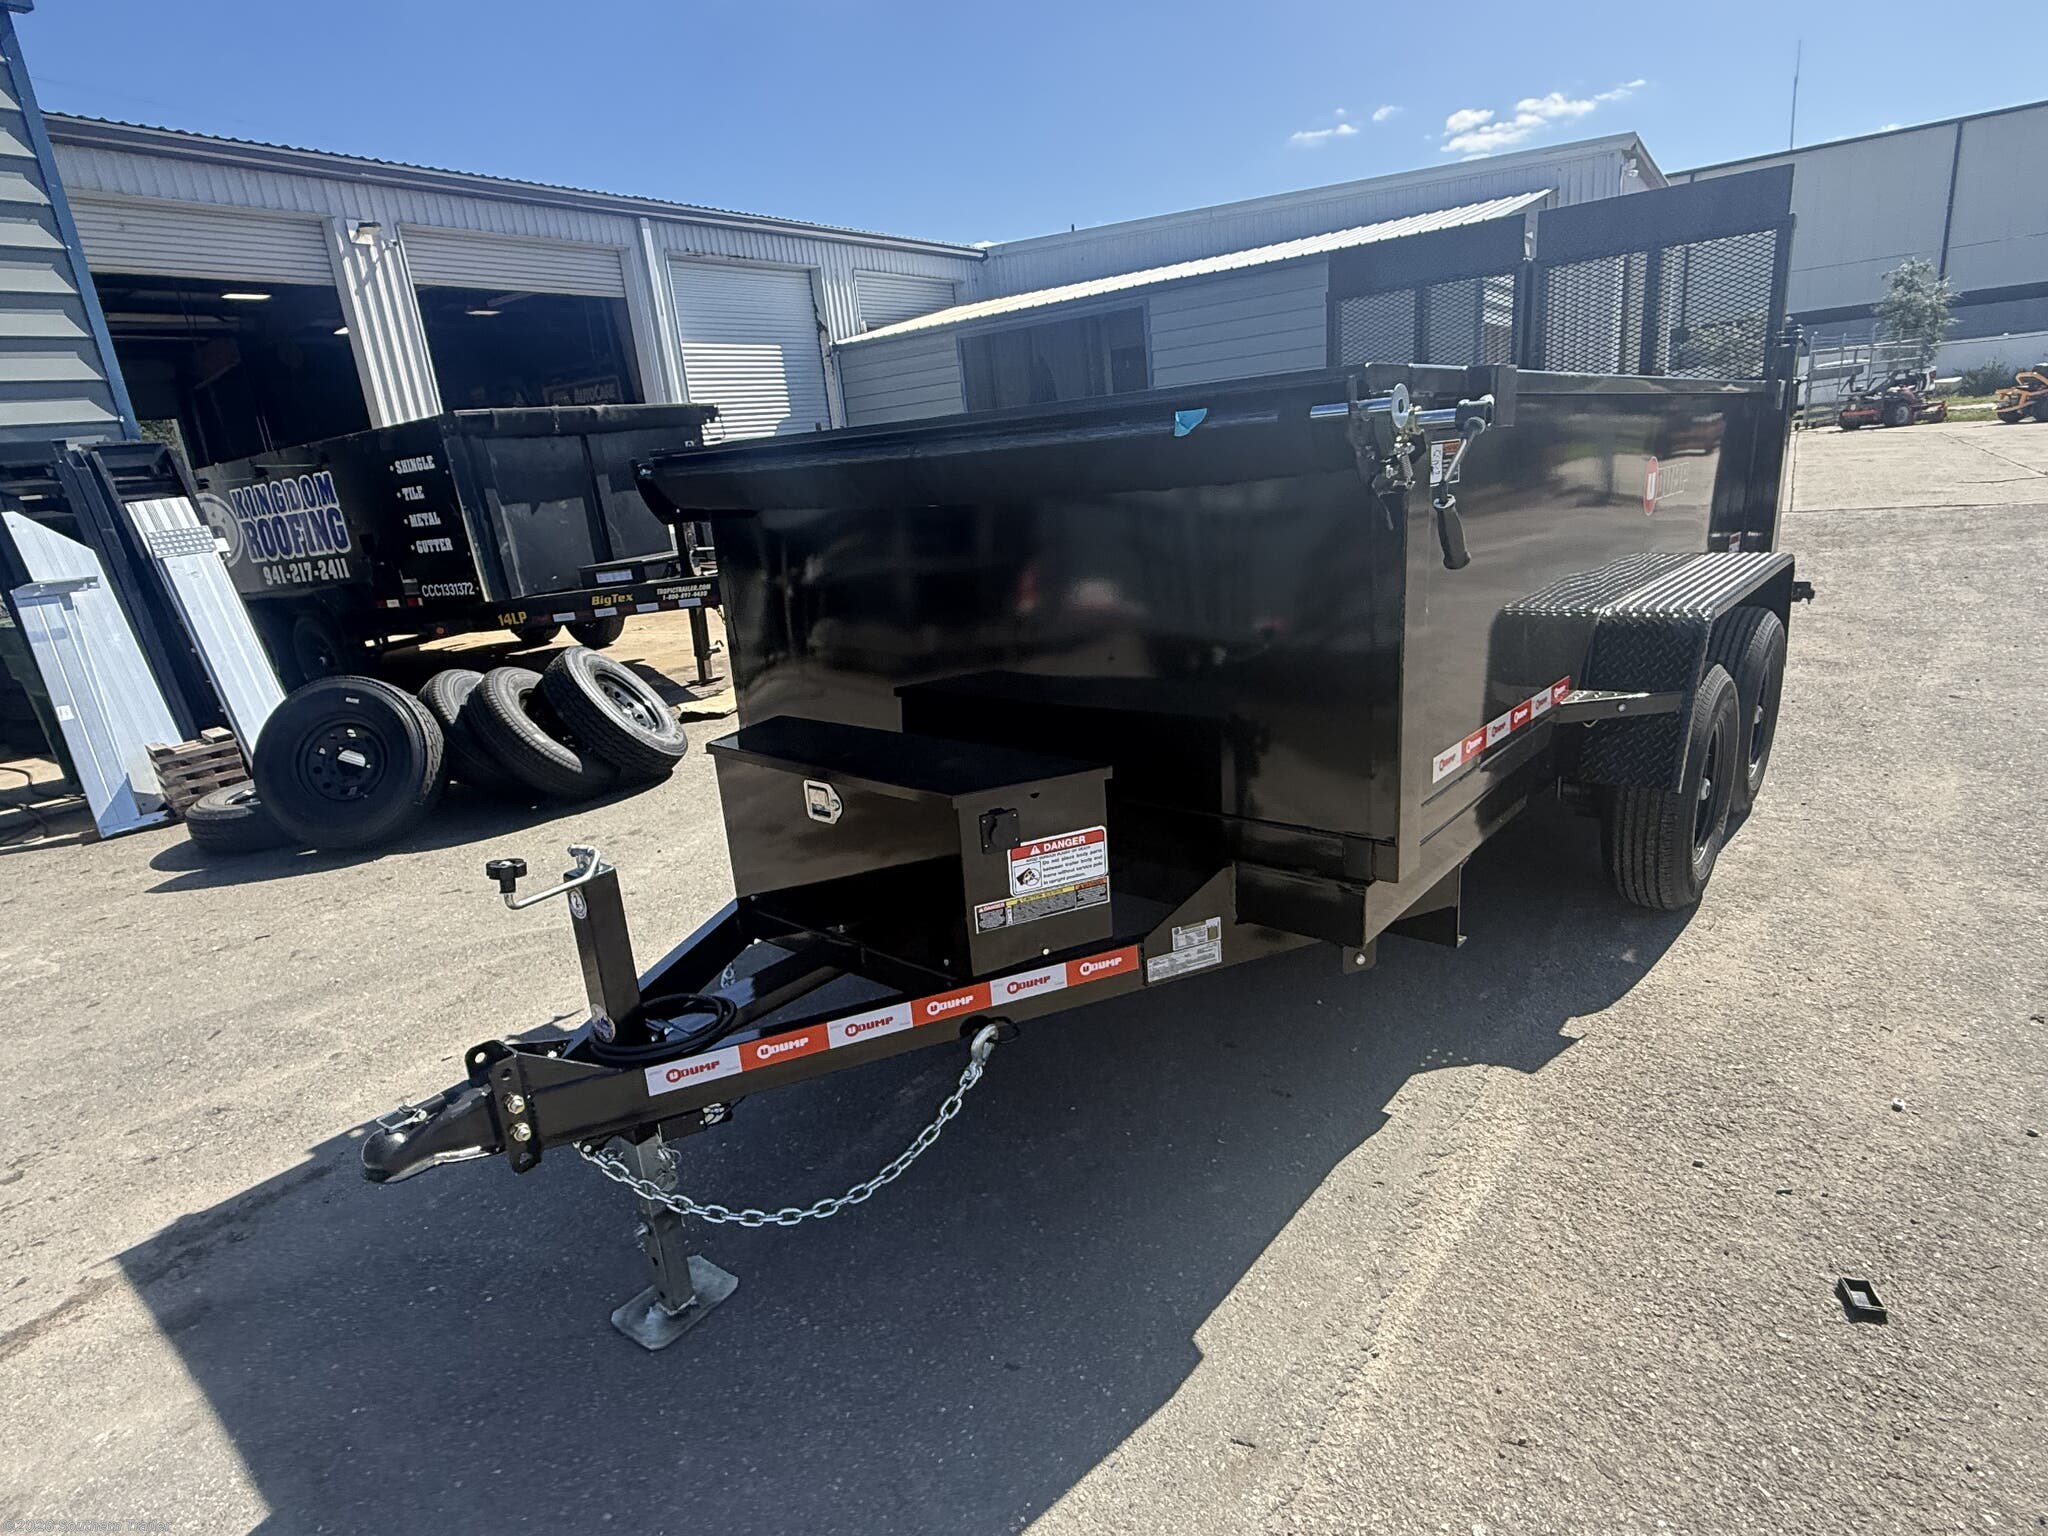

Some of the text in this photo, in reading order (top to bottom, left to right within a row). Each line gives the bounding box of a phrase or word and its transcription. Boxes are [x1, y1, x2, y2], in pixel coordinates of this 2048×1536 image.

[395, 455, 436, 474] SHINGLE
[229, 470, 340, 519] KINGDOM
[402, 485, 425, 501] TILE
[409, 512, 442, 527] METAL
[240, 506, 351, 563] ROOFING
[416, 537, 453, 554] GUTTER
[262, 558, 350, 586] 941-217-2411
[421, 582, 475, 597] CCC1331372
[592, 593, 634, 606] BigTex
[498, 611, 528, 626] 14LP
[1043, 835, 1086, 852] DANGER
